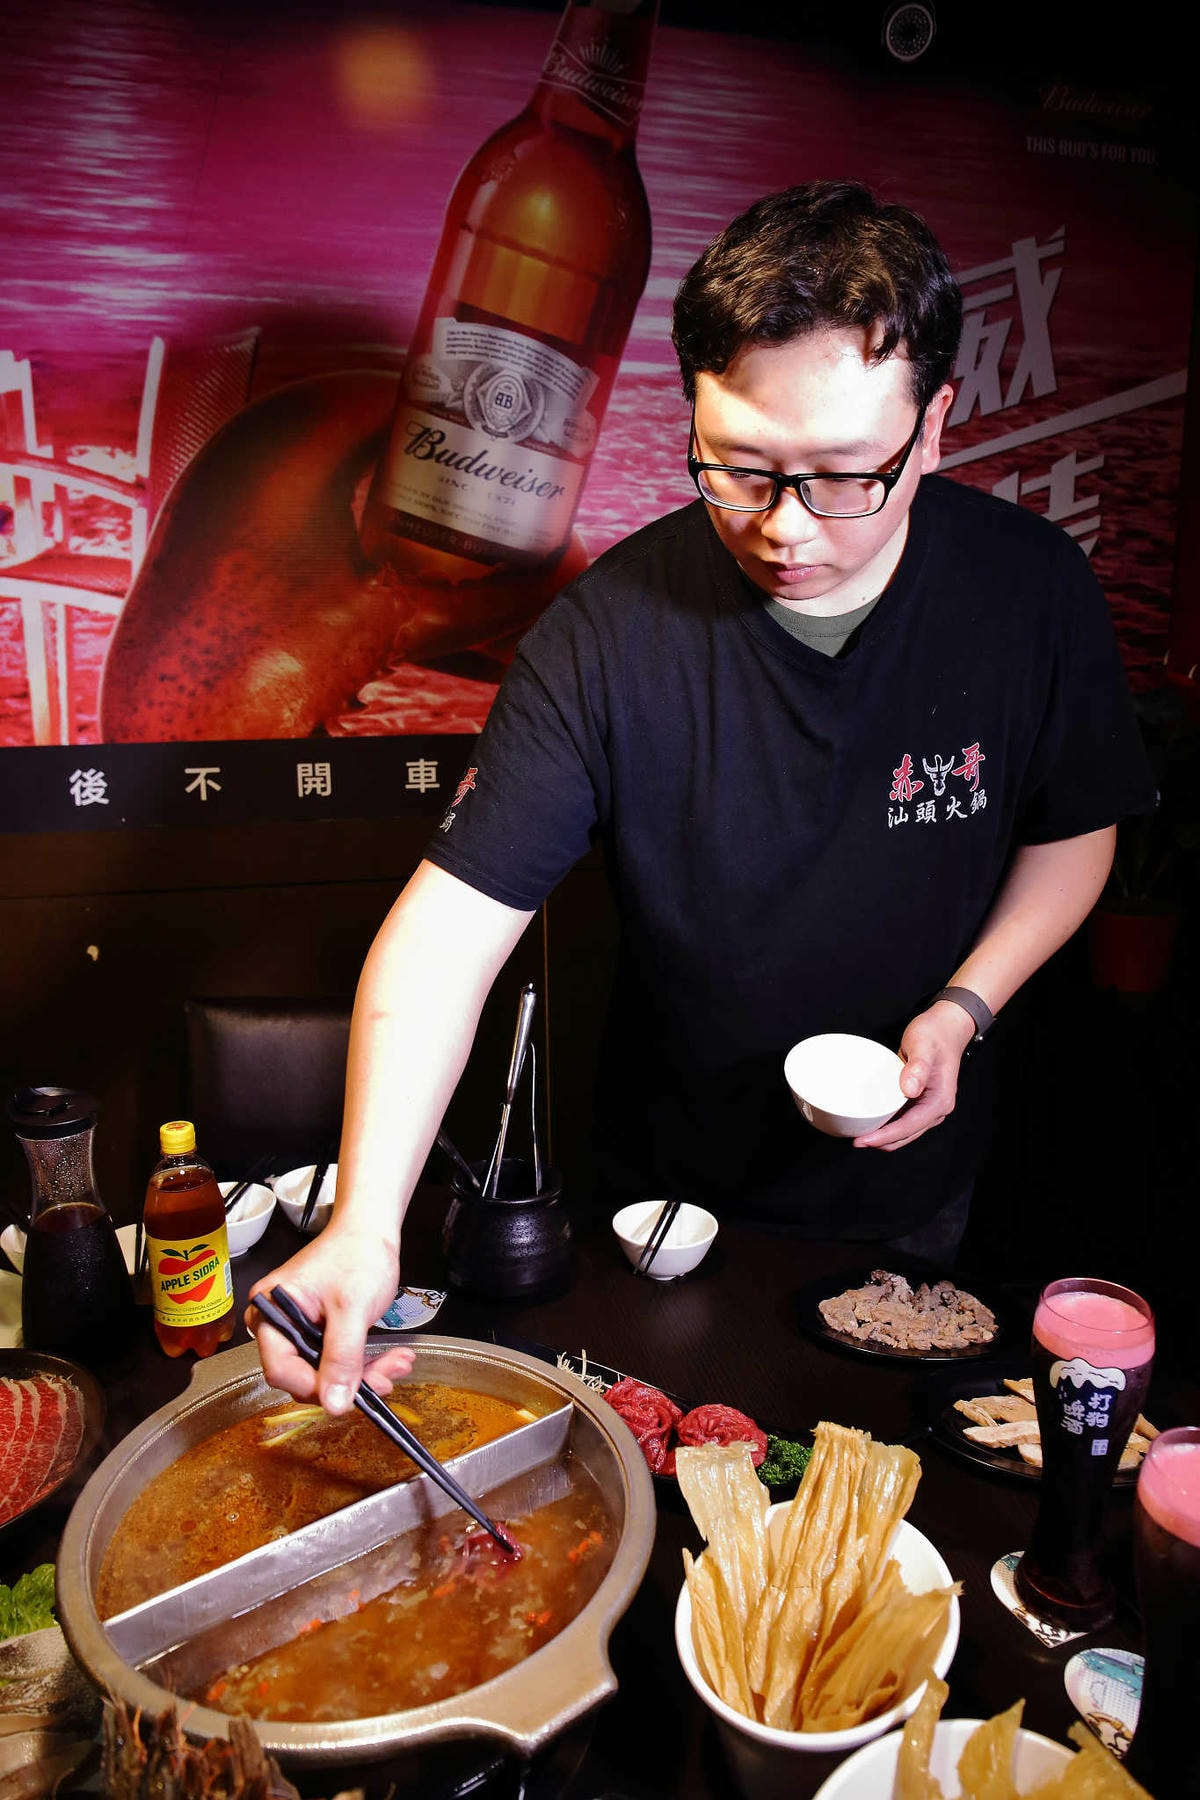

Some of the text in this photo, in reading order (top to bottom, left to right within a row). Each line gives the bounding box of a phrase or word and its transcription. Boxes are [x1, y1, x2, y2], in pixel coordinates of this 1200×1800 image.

[1026, 135, 1056, 154] THIS
[404, 421, 565, 500] Budweiser
[888, 789, 987, 828] 汕頭火鍋
[161, 1256, 220, 1292] APPLE SIDRA
[1085, 1392, 1112, 1428] 打狗
